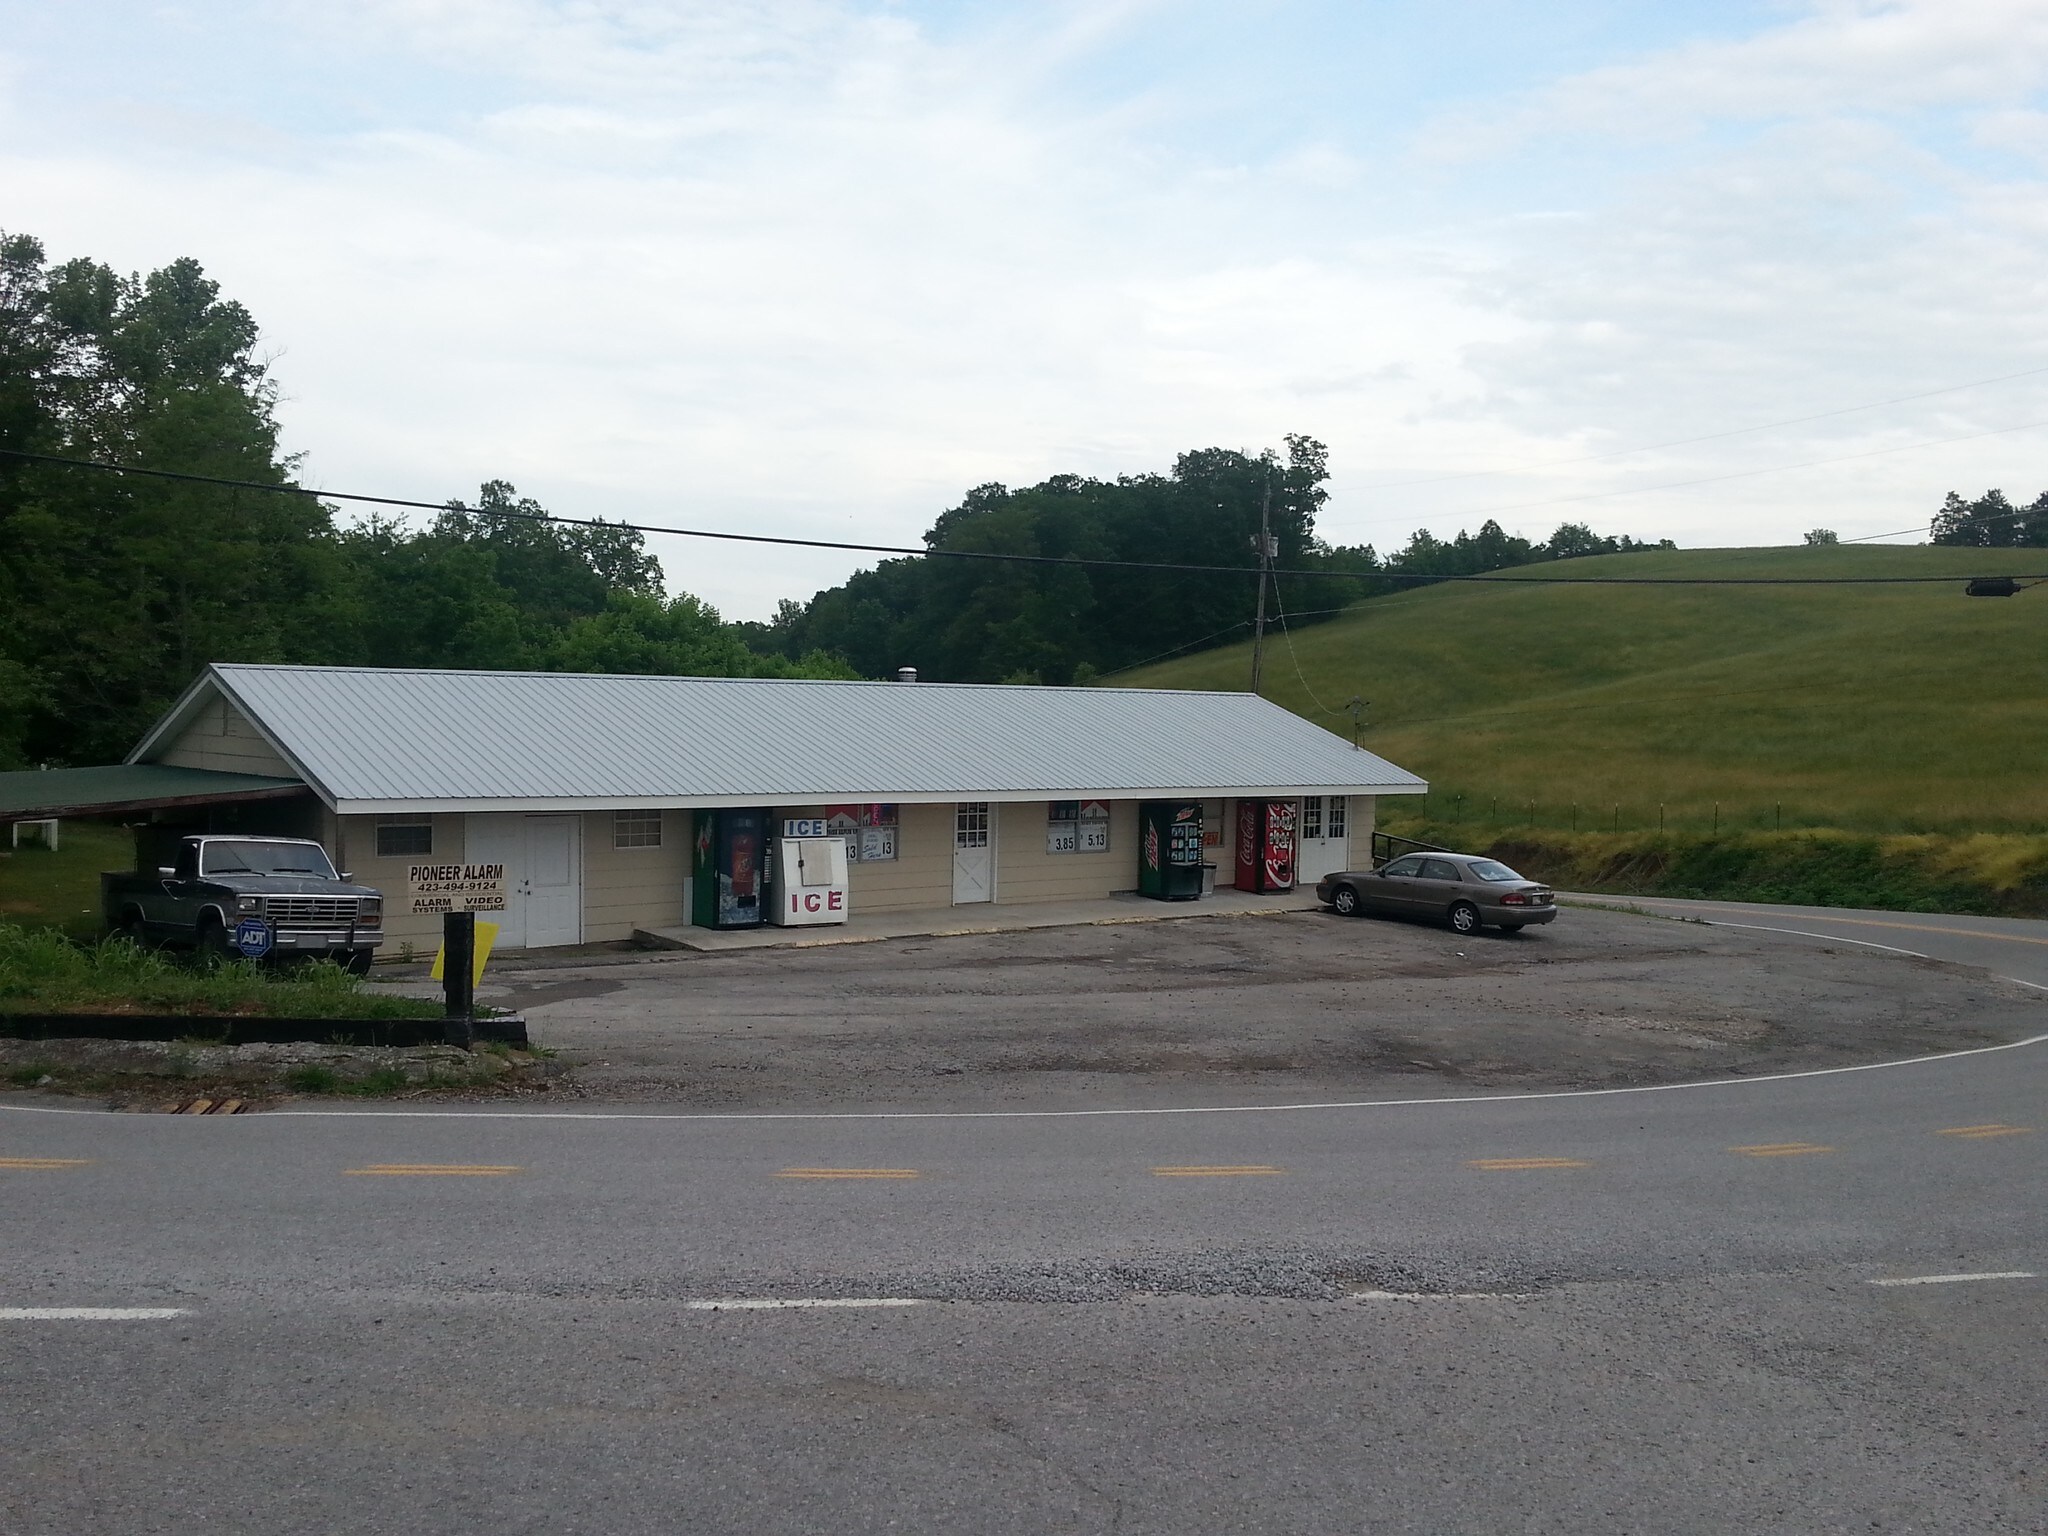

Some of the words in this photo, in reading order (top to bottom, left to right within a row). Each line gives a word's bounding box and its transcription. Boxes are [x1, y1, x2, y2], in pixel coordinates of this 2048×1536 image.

[789, 820, 822, 835] ICE
[1055, 837, 1074, 851] 3.85
[1088, 834, 1105, 847] 5.13
[411, 867, 461, 881] PIONEER
[464, 865, 503, 880] ALARM
[418, 882, 496, 892] 423-494-9124
[792, 891, 842, 912] ICE
[242, 931, 265, 946] ADT
